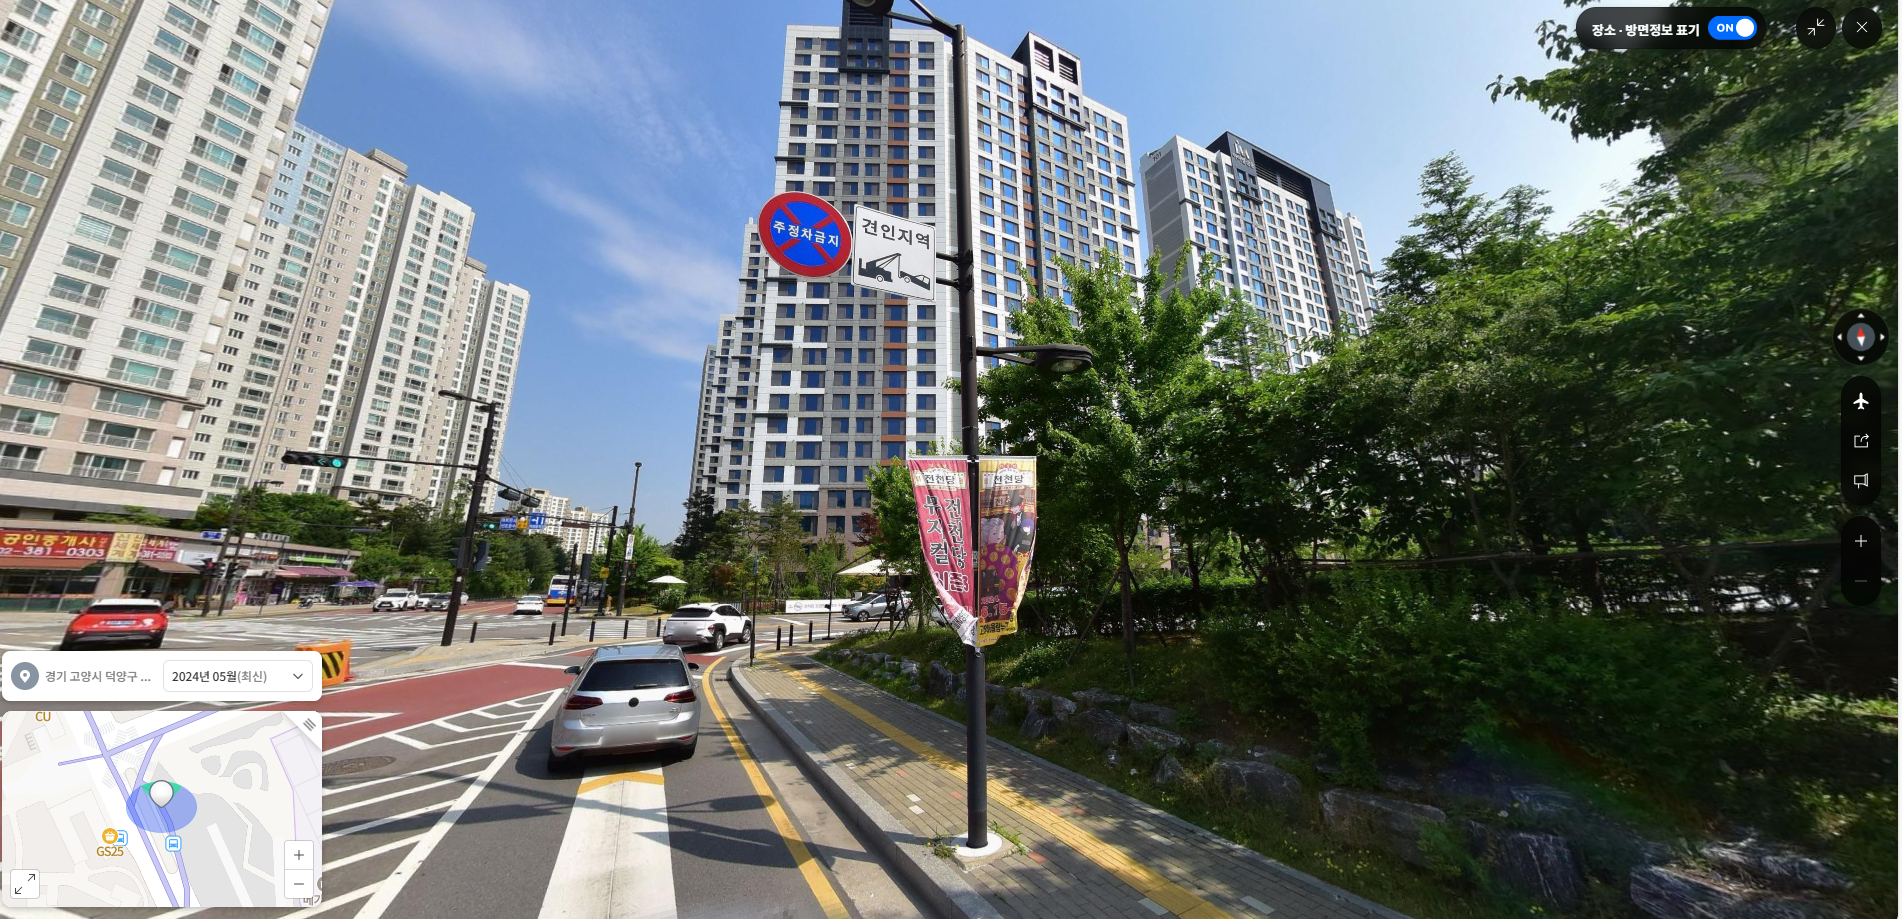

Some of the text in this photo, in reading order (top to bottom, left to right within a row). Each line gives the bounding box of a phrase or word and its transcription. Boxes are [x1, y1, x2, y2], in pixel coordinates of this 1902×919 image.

[773, 220, 839, 248] 주정차금지
[862, 218, 930, 250] 견인지역
[925, 473, 956, 485] 전천당
[994, 474, 1024, 485] 전천당
[3, 533, 97, 547] 공인중개사
[945, 497, 967, 569] 전천당
